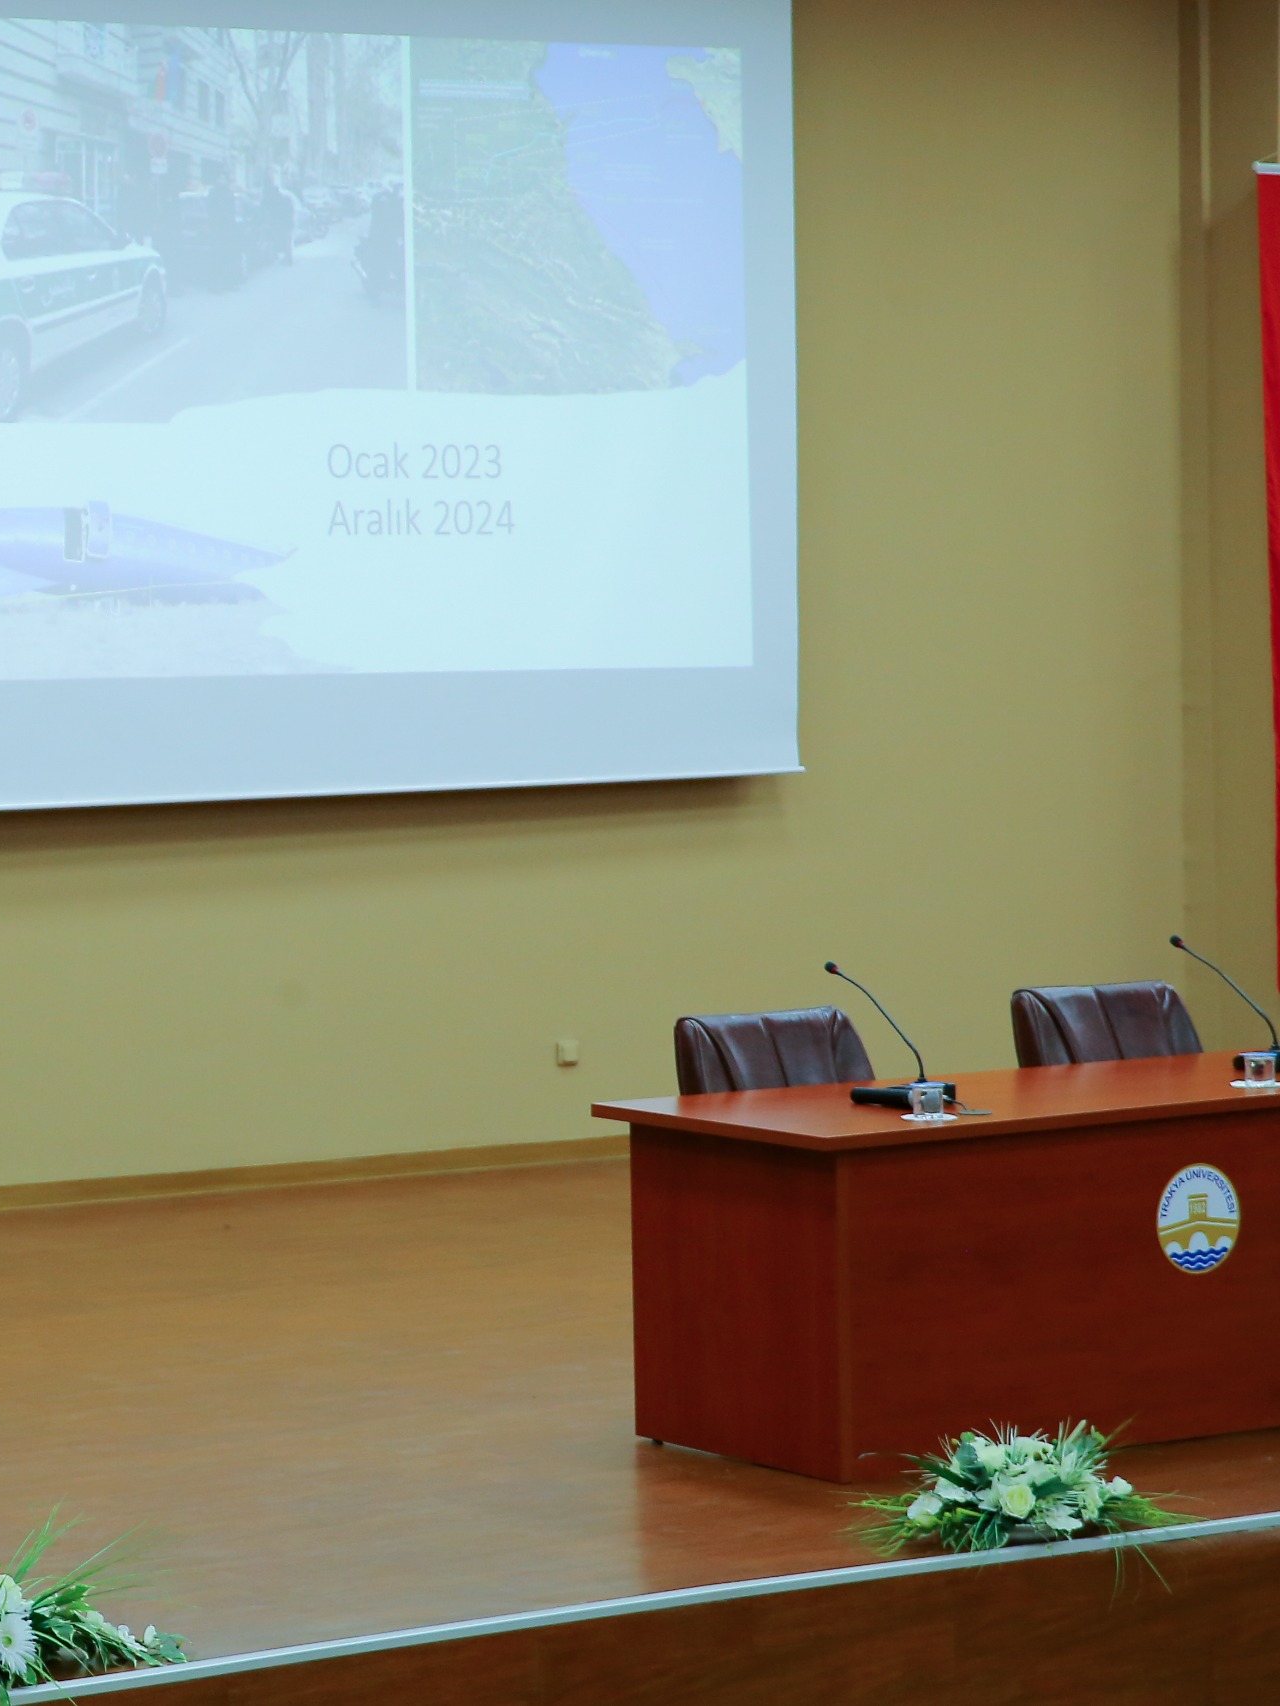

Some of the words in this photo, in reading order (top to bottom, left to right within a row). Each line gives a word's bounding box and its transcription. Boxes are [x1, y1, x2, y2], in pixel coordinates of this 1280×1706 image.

[327, 442, 409, 479] Ocak
[421, 444, 502, 479] 2023
[328, 499, 422, 535] Aralık
[433, 500, 515, 535] 2024
[1160, 1177, 1185, 1218] TRAKYA
